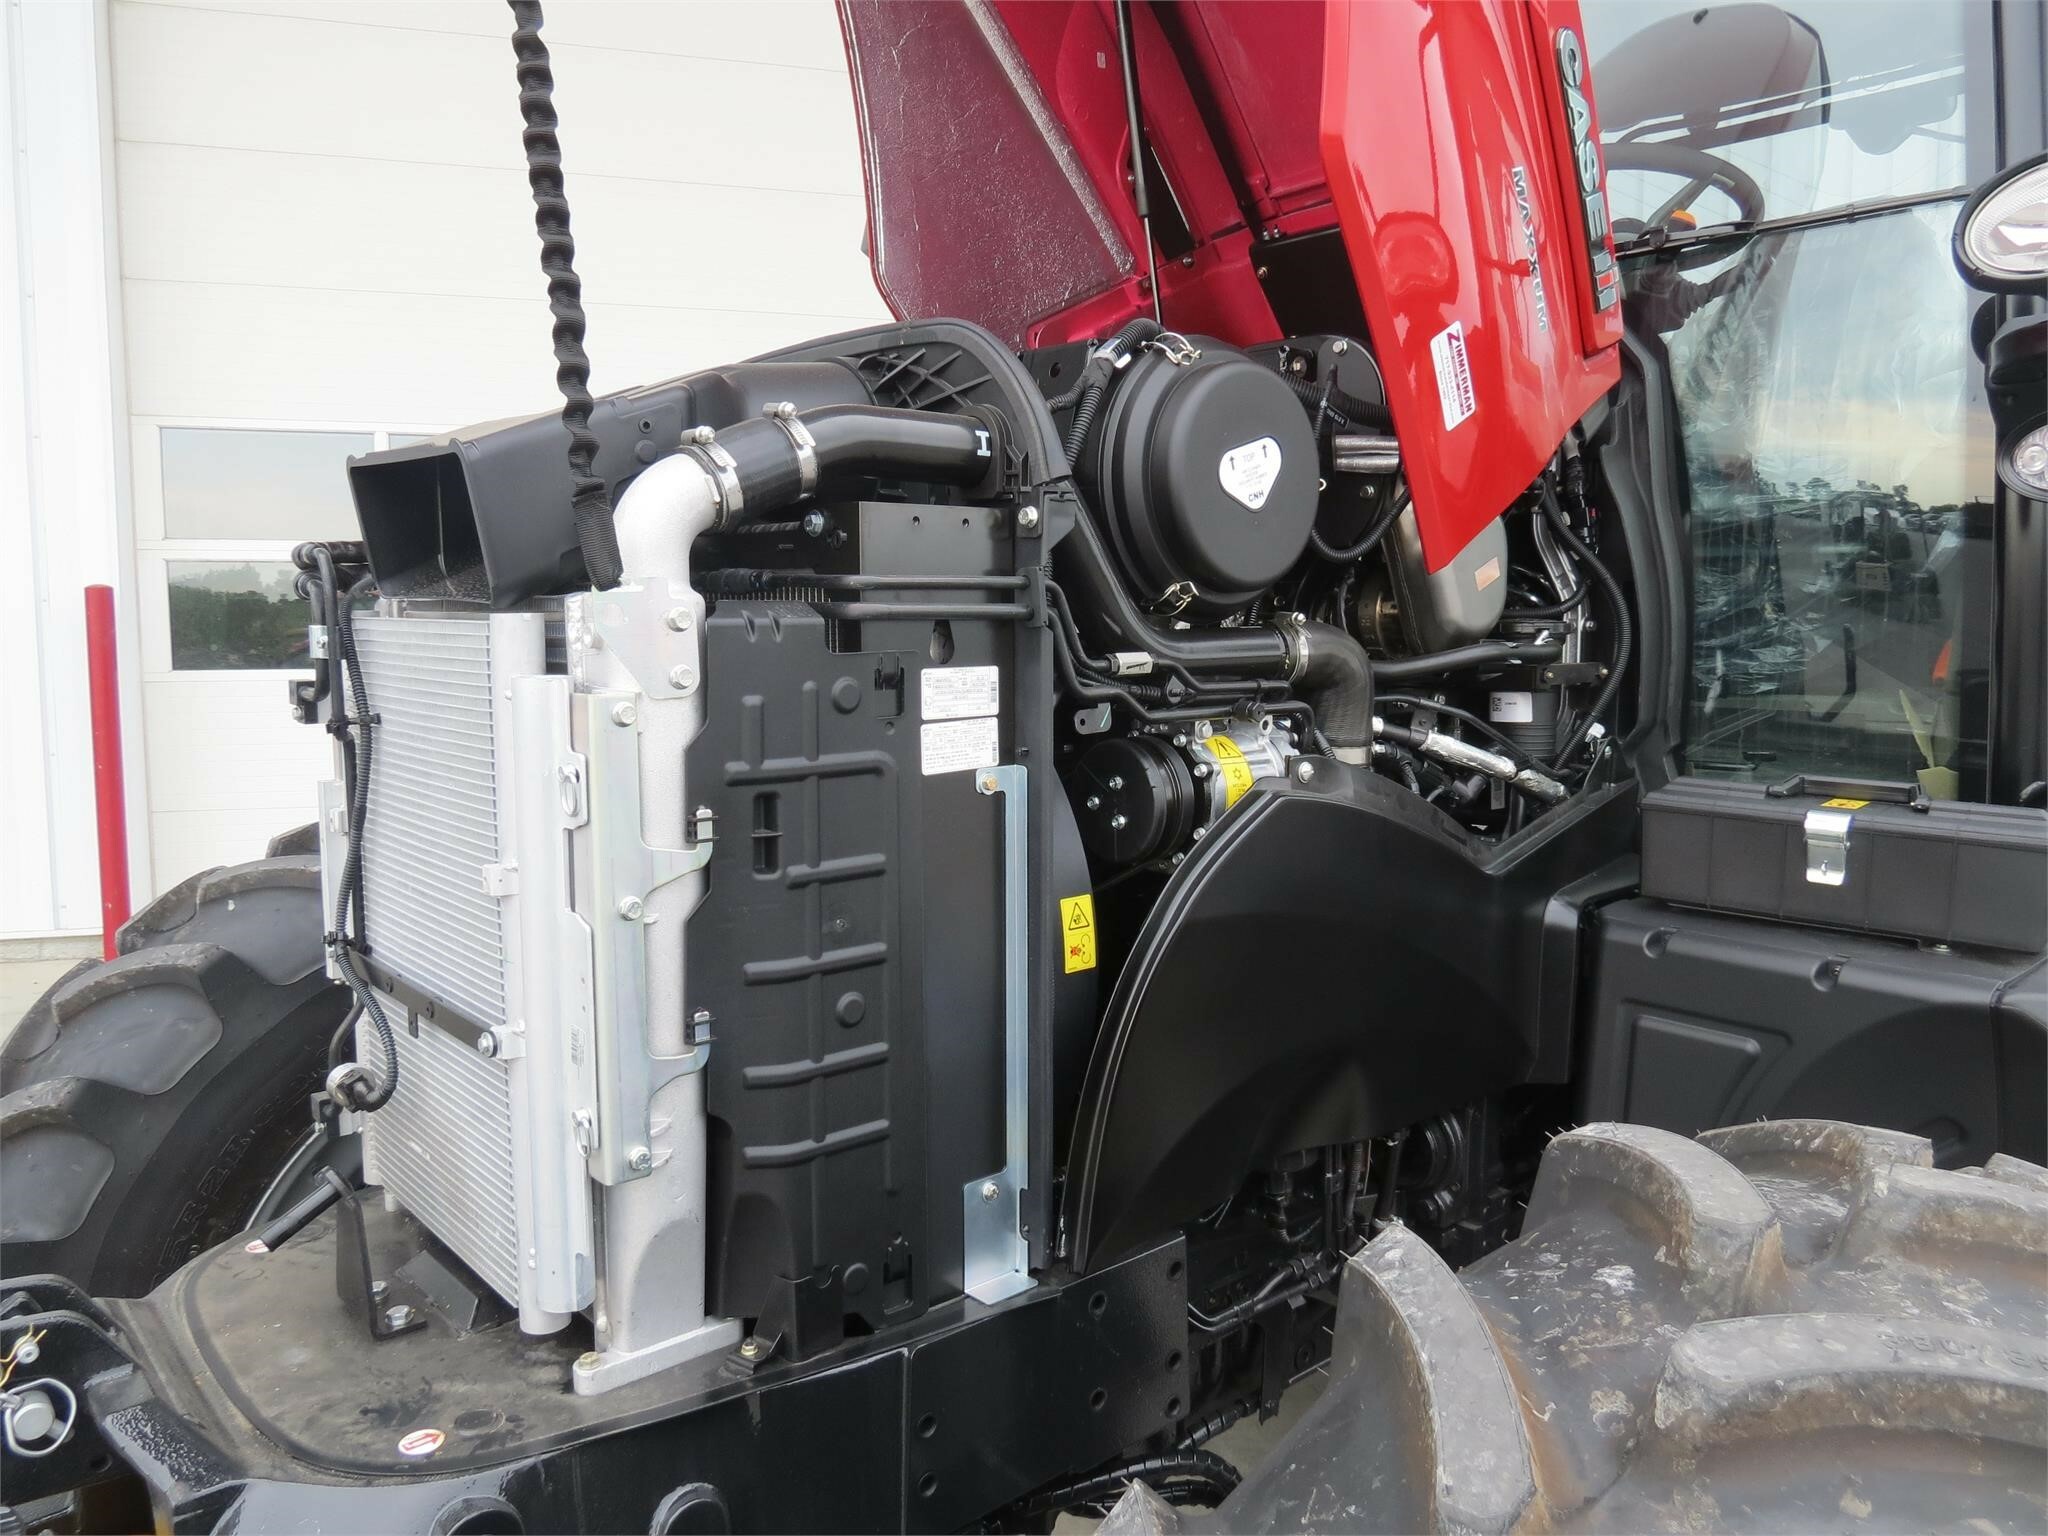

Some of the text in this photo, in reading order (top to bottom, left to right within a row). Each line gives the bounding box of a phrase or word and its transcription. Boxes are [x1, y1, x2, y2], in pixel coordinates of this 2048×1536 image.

[1556, 27, 1607, 241] CASE
[1512, 166, 1549, 332] MAXXUM
[1446, 329, 1473, 413] ZIMMERMAN
[1248, 489, 1265, 502] CNH
